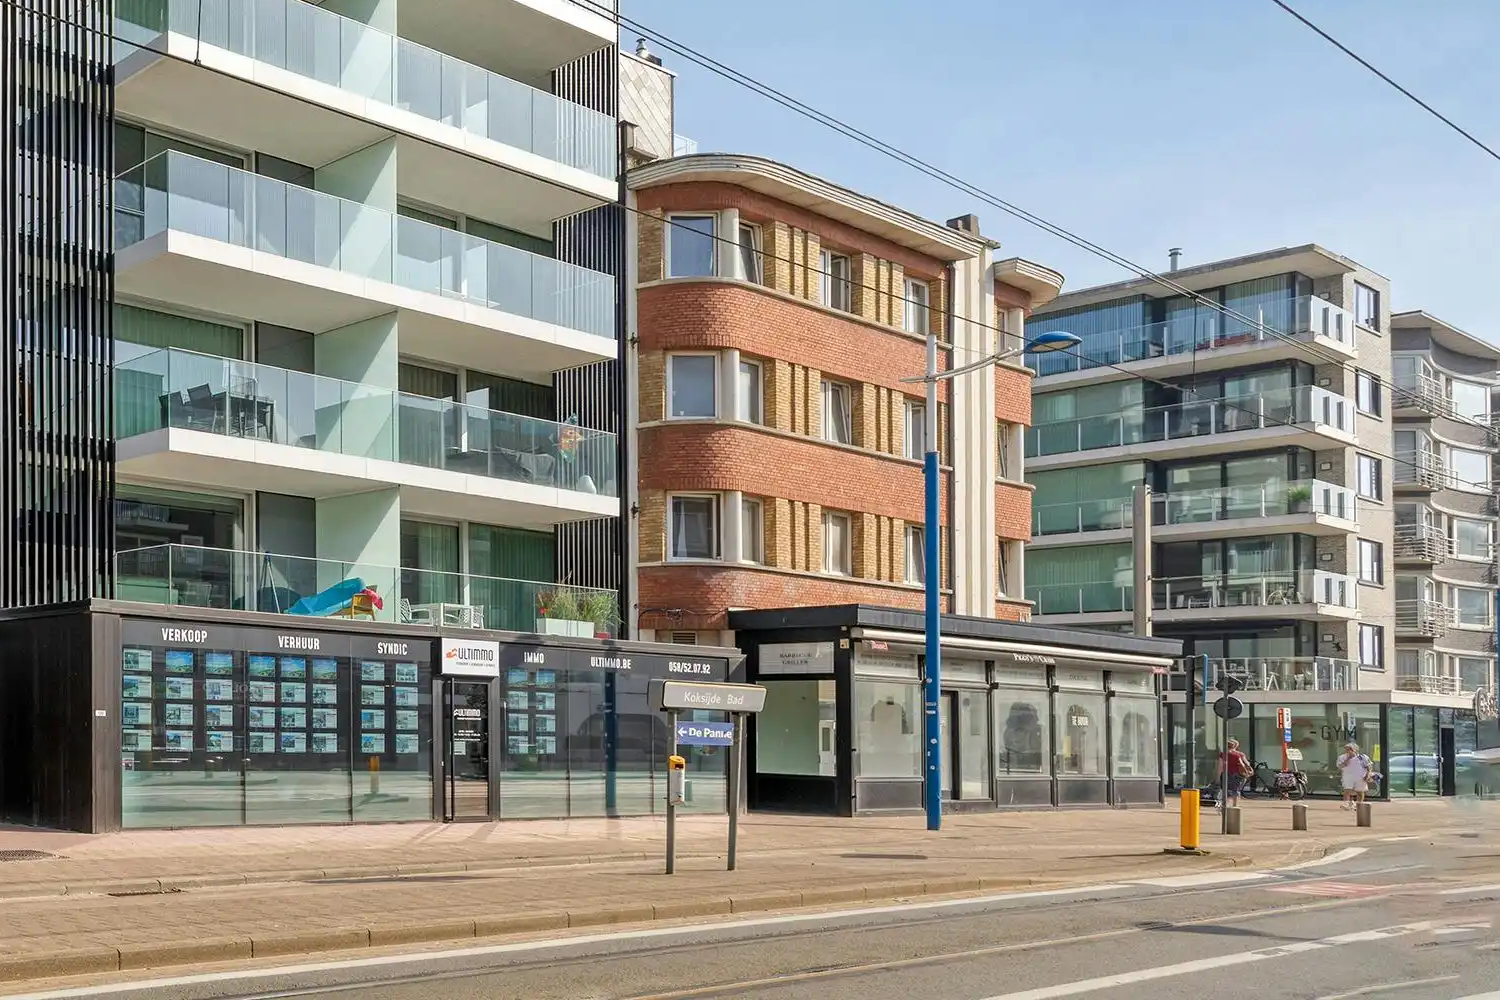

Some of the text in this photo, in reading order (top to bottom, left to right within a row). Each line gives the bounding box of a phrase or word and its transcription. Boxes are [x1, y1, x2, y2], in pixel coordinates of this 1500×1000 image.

[161, 627, 408, 656] VERKOOP VERHUUR SYNDIC
[458, 647, 493, 661] ULTIMMO
[523, 652, 545, 664] IMMO
[590, 656, 632, 670] ULTIMMO.BE
[684, 691, 745, 705] Koksijde Bad
[689, 727, 702, 738] De
